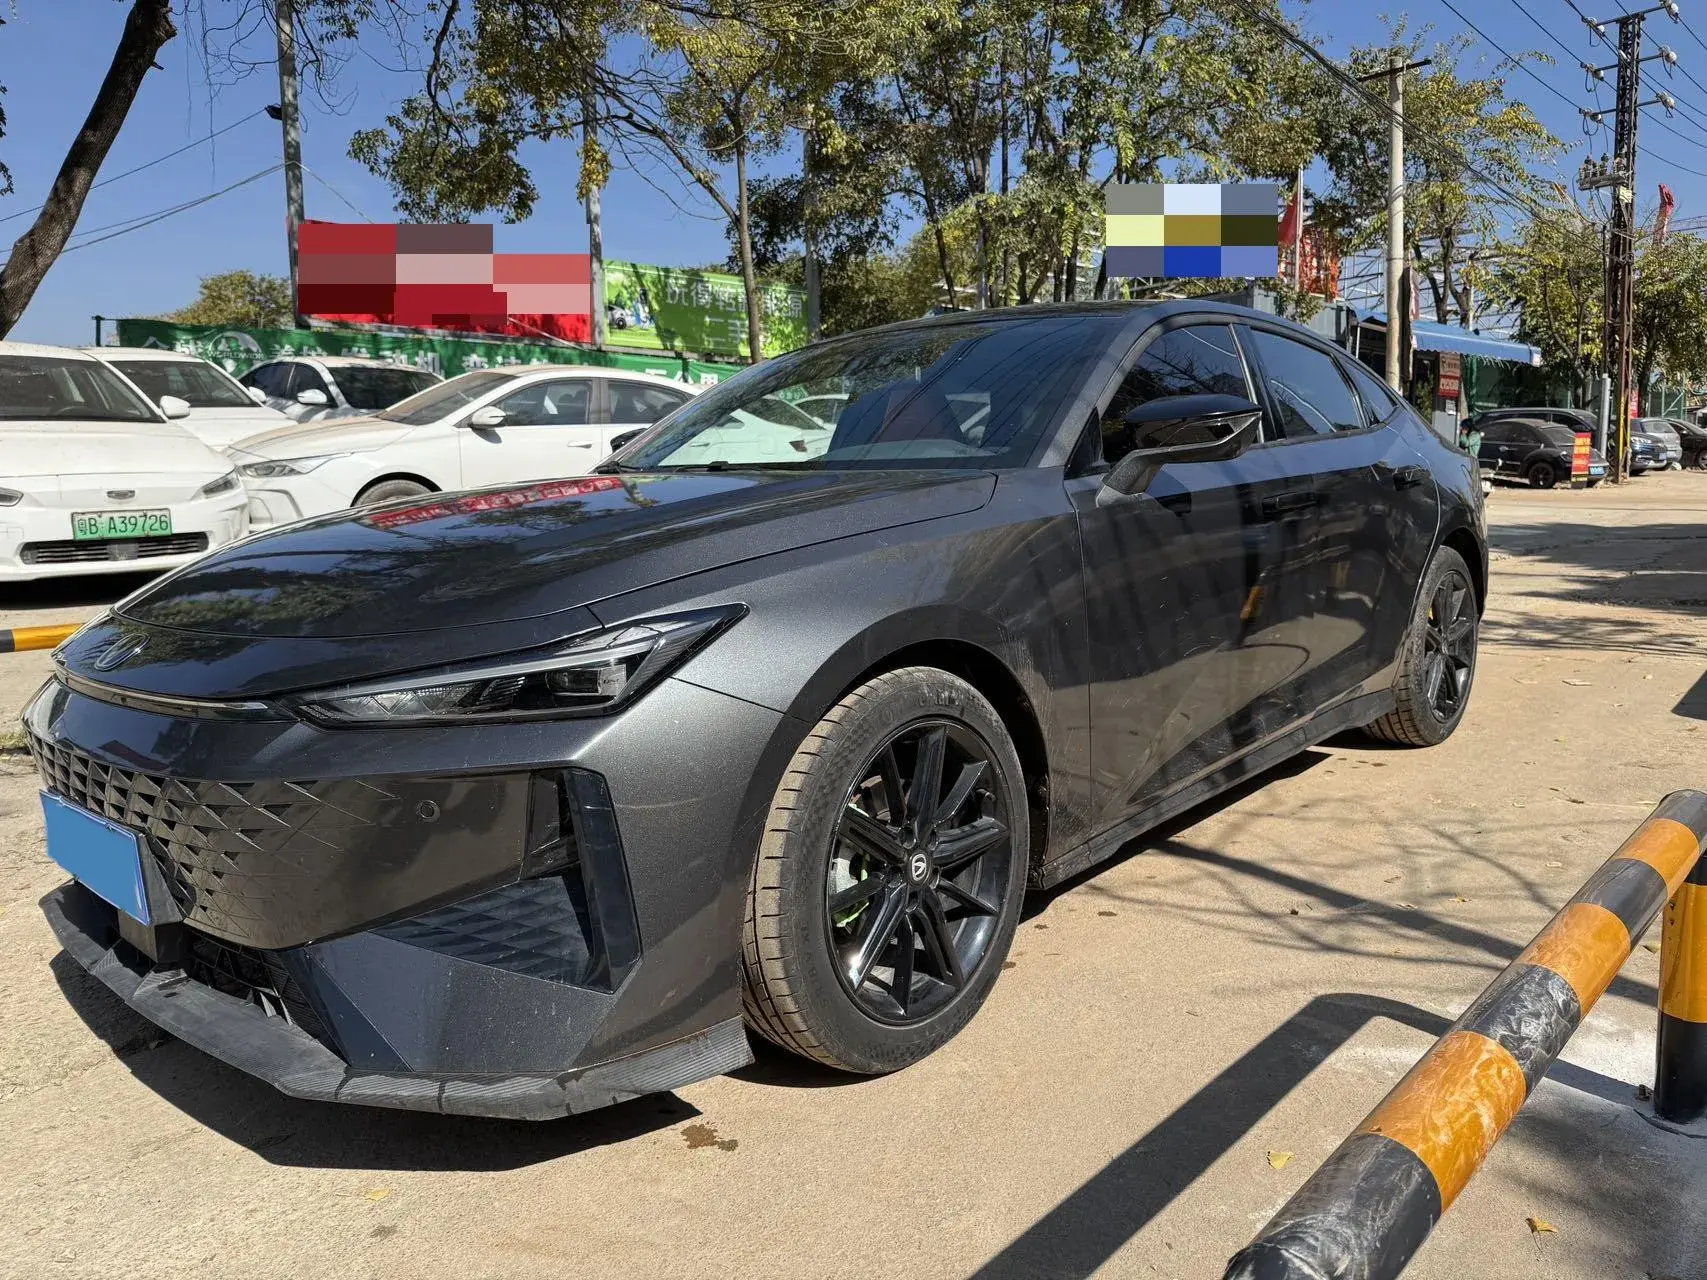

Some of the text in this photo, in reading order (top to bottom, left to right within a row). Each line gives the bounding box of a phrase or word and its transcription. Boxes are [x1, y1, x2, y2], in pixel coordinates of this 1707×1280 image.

[704, 317, 750, 344] 二手
[77, 514, 169, 536] 粤B A39726
